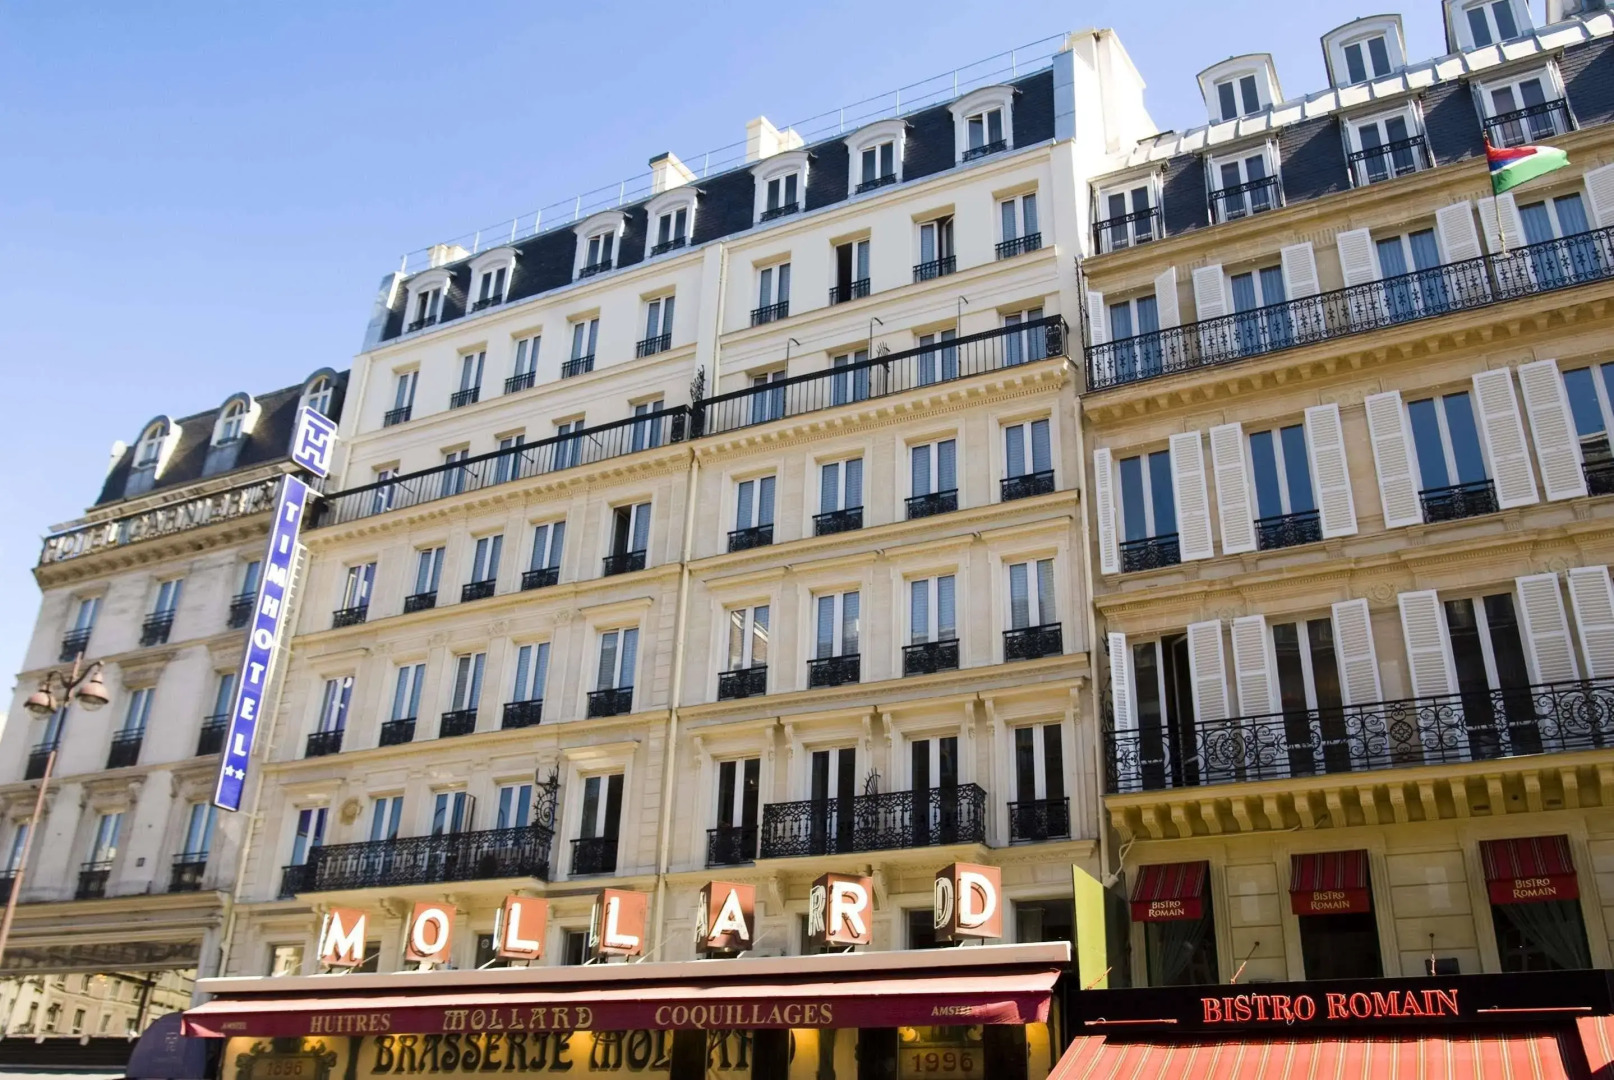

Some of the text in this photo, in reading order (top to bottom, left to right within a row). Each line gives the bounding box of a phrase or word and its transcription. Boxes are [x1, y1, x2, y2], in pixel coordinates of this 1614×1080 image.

[233, 502, 299, 757] TIMHOTEL
[1513, 887, 1556, 898] ROMAIN
[1515, 878, 1549, 889] BISTRO
[1152, 900, 1181, 909] BISTRO
[1313, 891, 1345, 900] BISTRO
[1148, 908, 1185, 918] ROMAIN
[1311, 900, 1350, 911] ROMAIN
[322, 871, 998, 962] MOLLARD
[1201, 989, 1459, 1024] BISTRO ROMAIN
[310, 1013, 391, 1032] HUITRES
[443, 1006, 593, 1030] MOLLARD
[655, 1004, 832, 1029] COQUILLAGES
[912, 1052, 974, 1073] 1996
